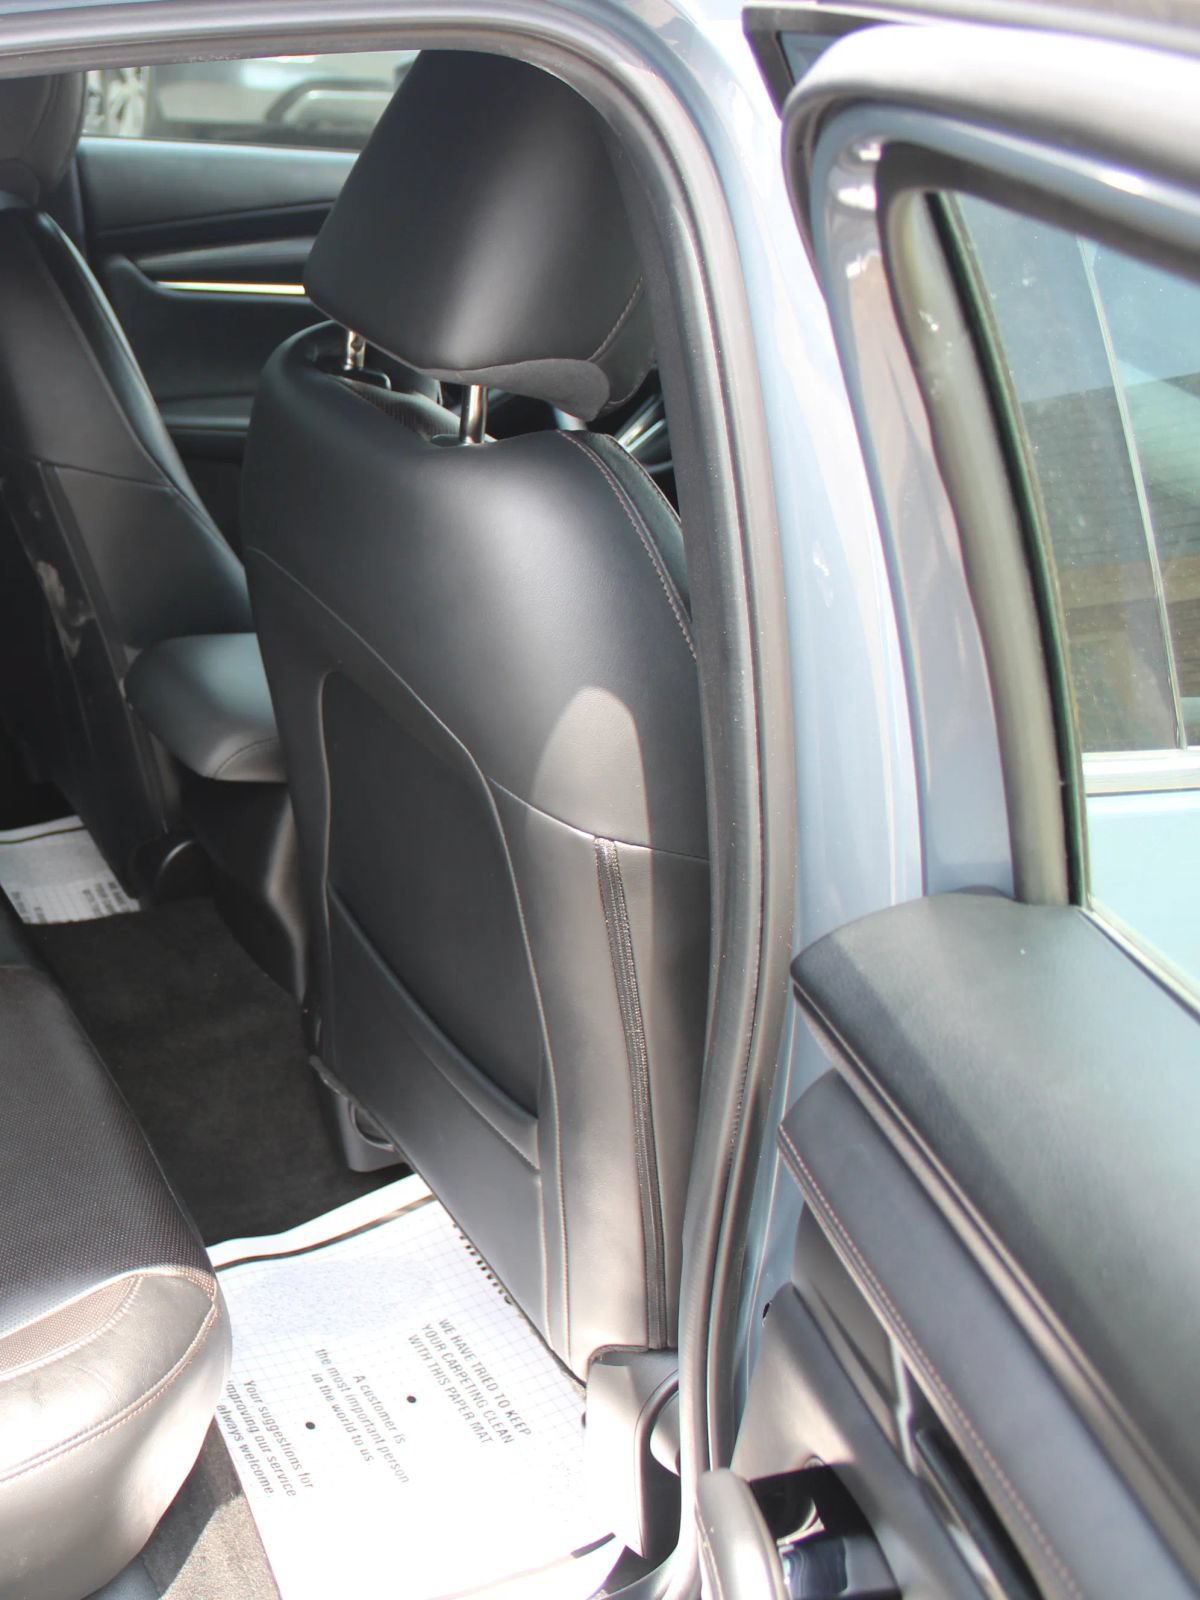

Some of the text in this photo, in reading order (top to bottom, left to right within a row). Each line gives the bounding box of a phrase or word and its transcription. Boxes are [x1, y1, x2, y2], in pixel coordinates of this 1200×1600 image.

[216, 1405, 245, 1442] always
[311, 1373, 324, 1383] in
[319, 1385, 335, 1402] the
[331, 1404, 358, 1433] world
[352, 1434, 364, 1446] to
[315, 1348, 410, 1483] the most important person
[353, 1375, 406, 1444] A customer is
[408, 1334, 493, 1443] WITH THIS PAPER MAT
[422, 1323, 515, 1443] YOUR CARPETING CLEAN
[438, 1318, 532, 1435] WE HAVE TRIED TO KEEP
[244, 1380, 314, 1488] Your suggestions for
[254, 1435, 272, 1453] our
[267, 1456, 297, 1497] service
